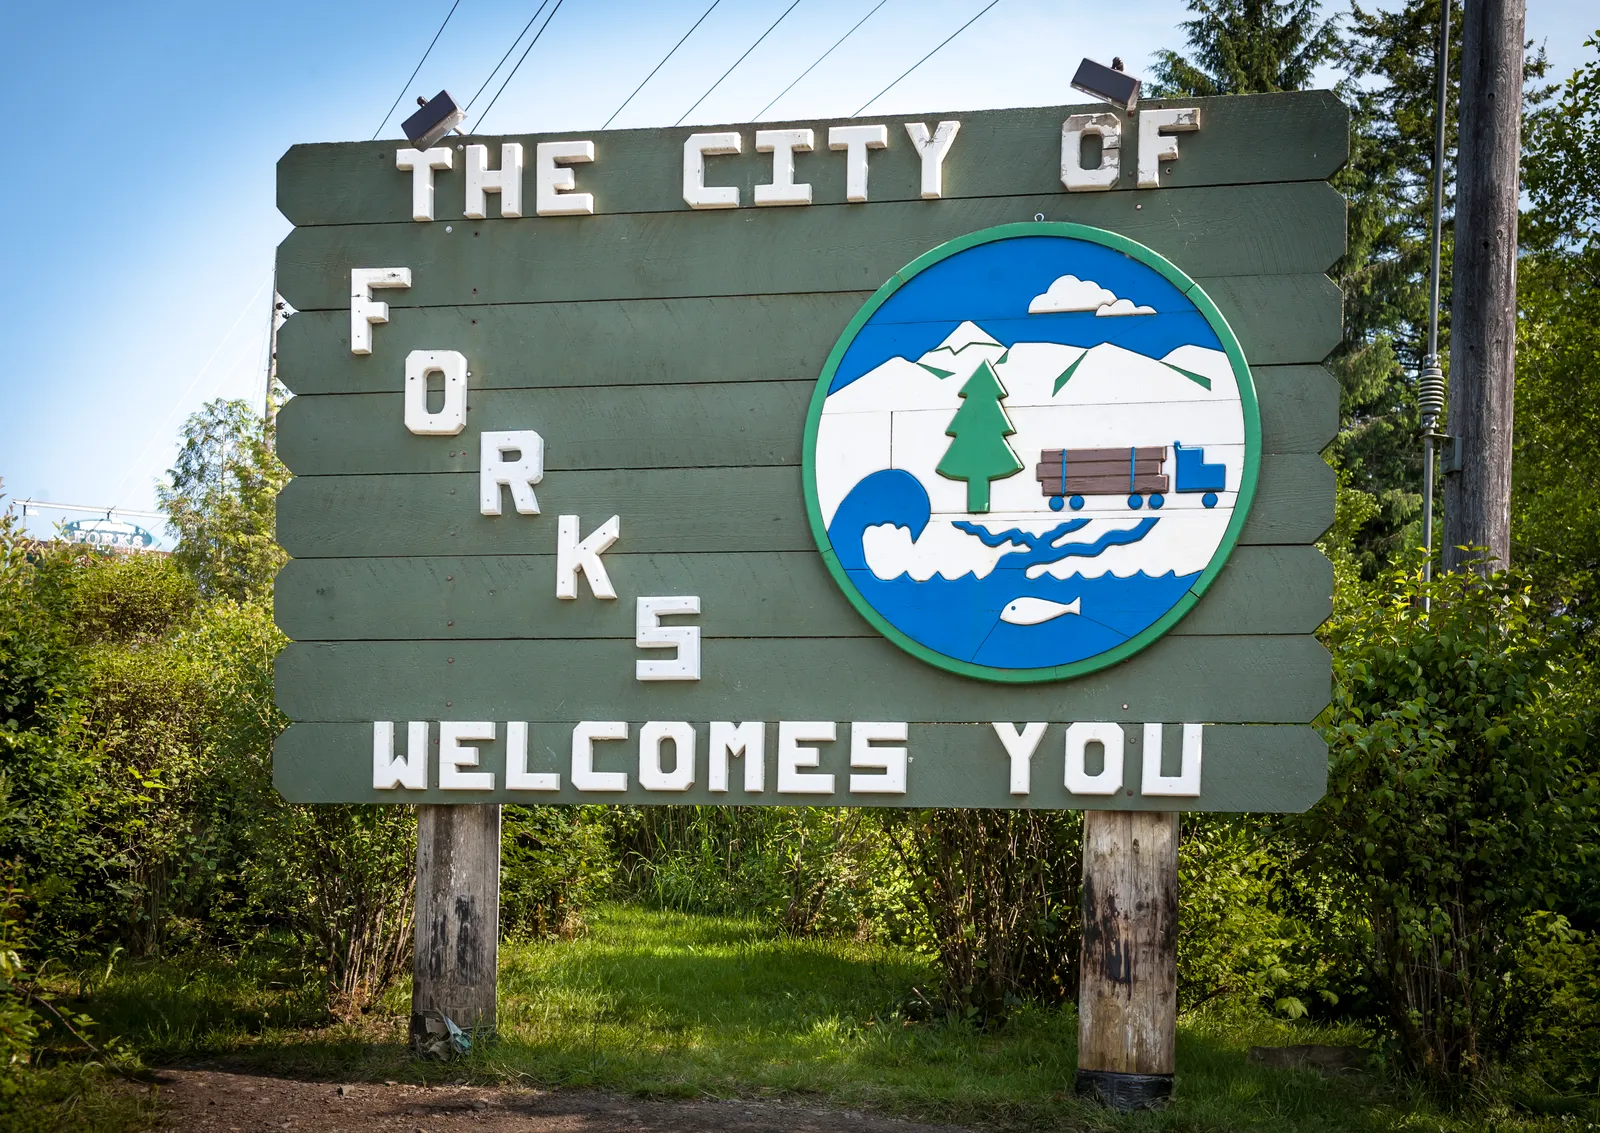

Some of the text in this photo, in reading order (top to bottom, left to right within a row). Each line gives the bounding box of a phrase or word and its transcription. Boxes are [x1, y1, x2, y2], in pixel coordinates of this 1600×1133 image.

[395, 107, 1201, 222] THE CITY OF
[350, 267, 702, 681] FORKS
[73, 530, 143, 548] FORKS
[371, 720, 1204, 797] WELCOMES YOU
